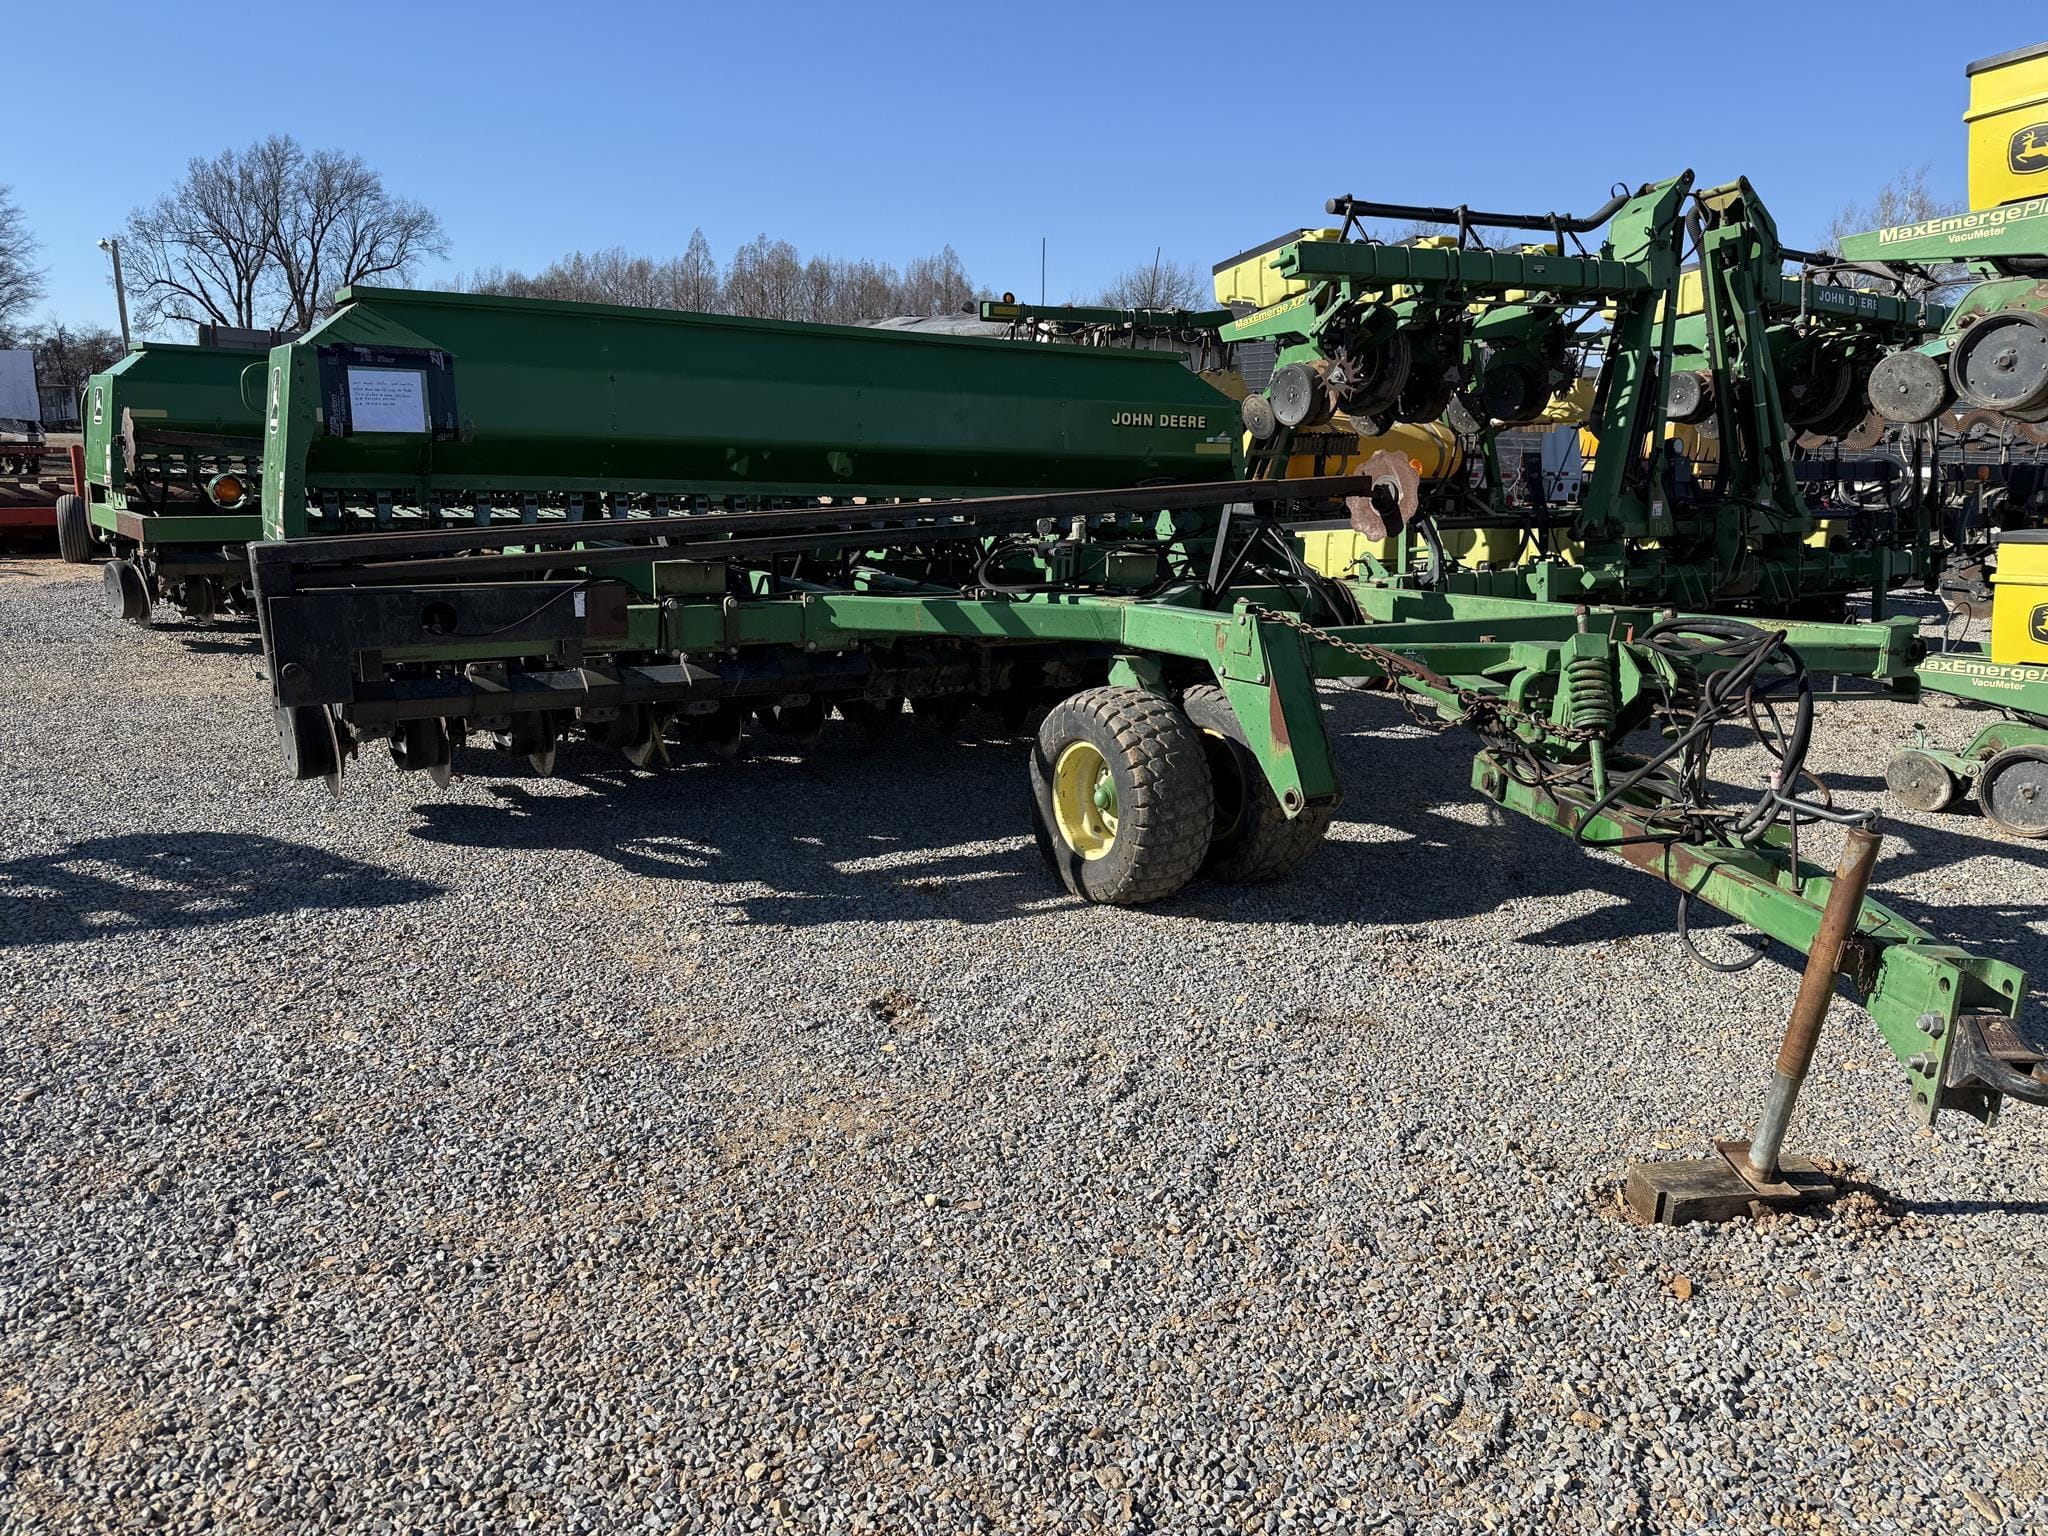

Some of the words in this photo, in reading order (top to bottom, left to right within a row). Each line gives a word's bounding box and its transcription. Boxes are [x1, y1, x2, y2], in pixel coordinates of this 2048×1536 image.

[1948, 226, 2006, 243] VacuMeter
[1819, 290, 1844, 304] JOHN
[1849, 295, 1878, 310] DERE
[1111, 412, 1153, 426] JOHN
[1160, 414, 1206, 428] DEERE
[1971, 677, 2026, 691] VacuMeter
